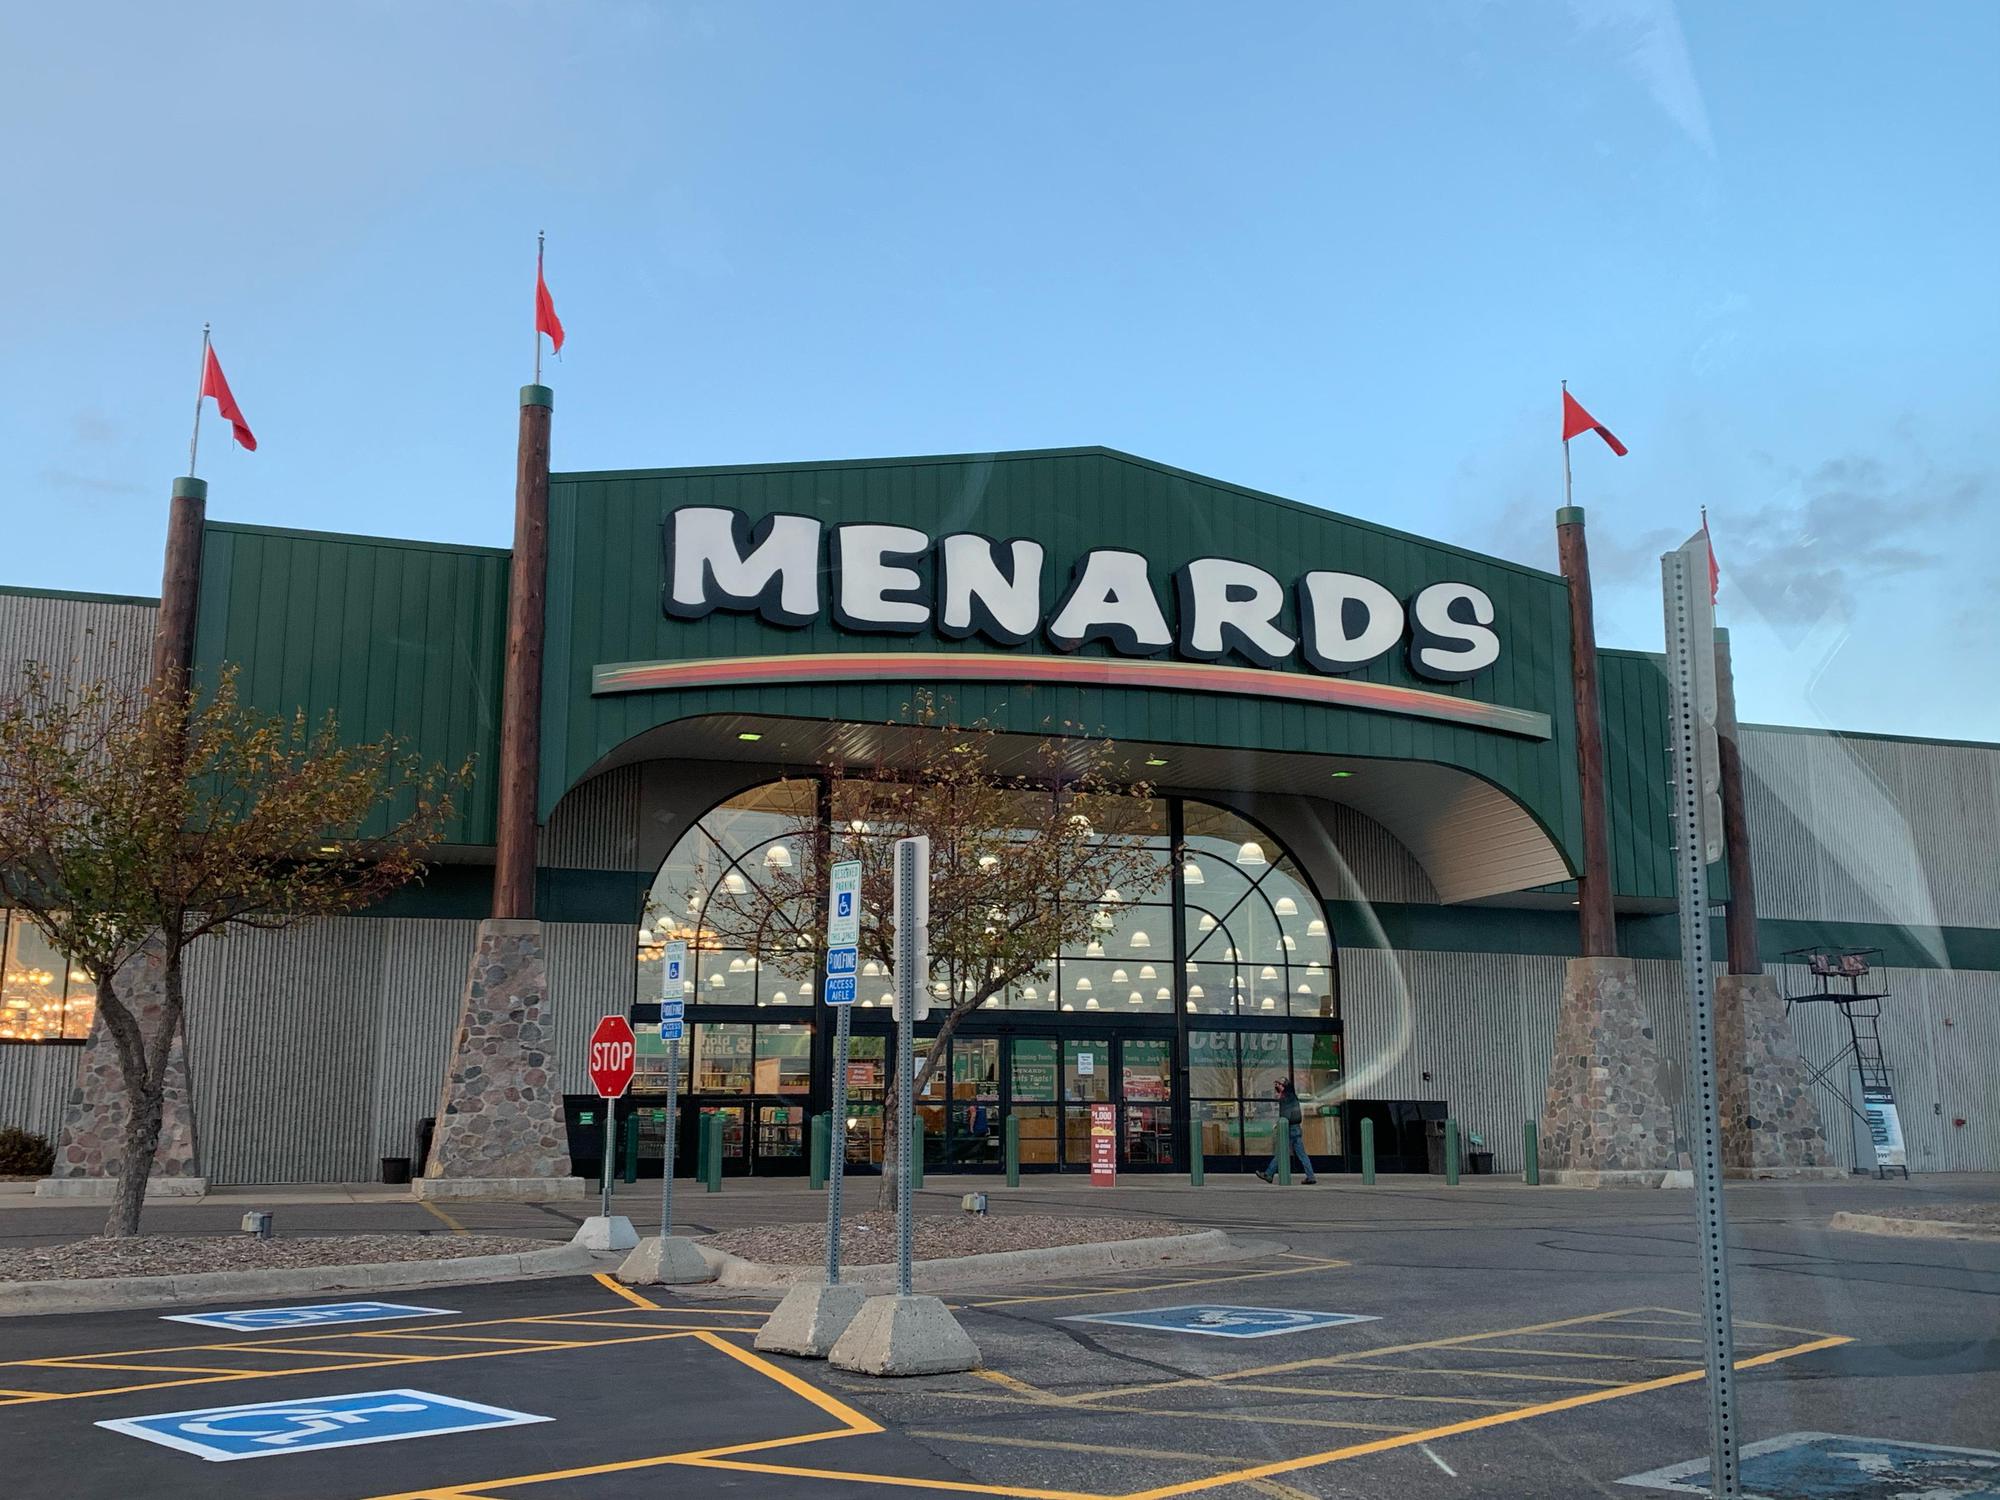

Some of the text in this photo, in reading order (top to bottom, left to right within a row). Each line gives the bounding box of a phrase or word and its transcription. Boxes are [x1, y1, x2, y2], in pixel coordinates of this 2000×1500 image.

[669, 505, 1500, 678] MENARDS
[834, 866, 858, 879] RESERVED
[835, 880, 856, 892] PARKING
[829, 979, 854, 990] ACCESS
[663, 1023, 681, 1031] ACCESS
[592, 1041, 633, 1072] STOP
[1091, 1111, 1112, 1121] $1,000
